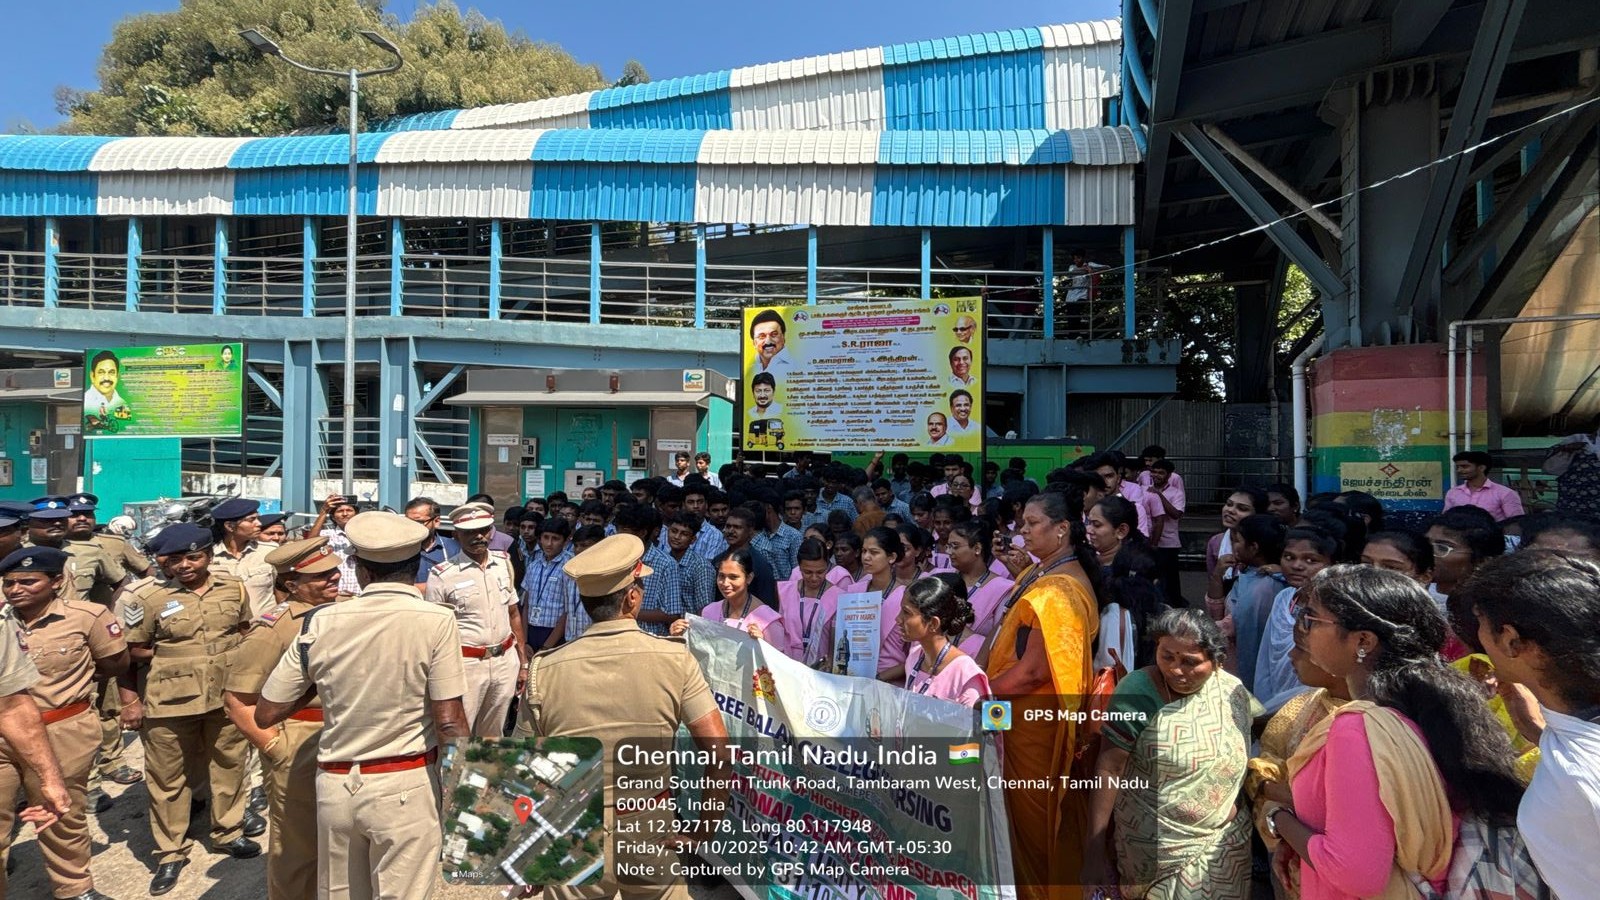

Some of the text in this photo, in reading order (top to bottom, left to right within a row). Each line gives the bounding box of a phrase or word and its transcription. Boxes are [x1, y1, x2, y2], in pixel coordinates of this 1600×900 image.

[1342, 476, 1432, 489] ஜெயச்சந்திரன்
[711, 689, 745, 721] REE
[731, 770, 793, 827] ATIONAL
[728, 794, 798, 858] ATIONAL
